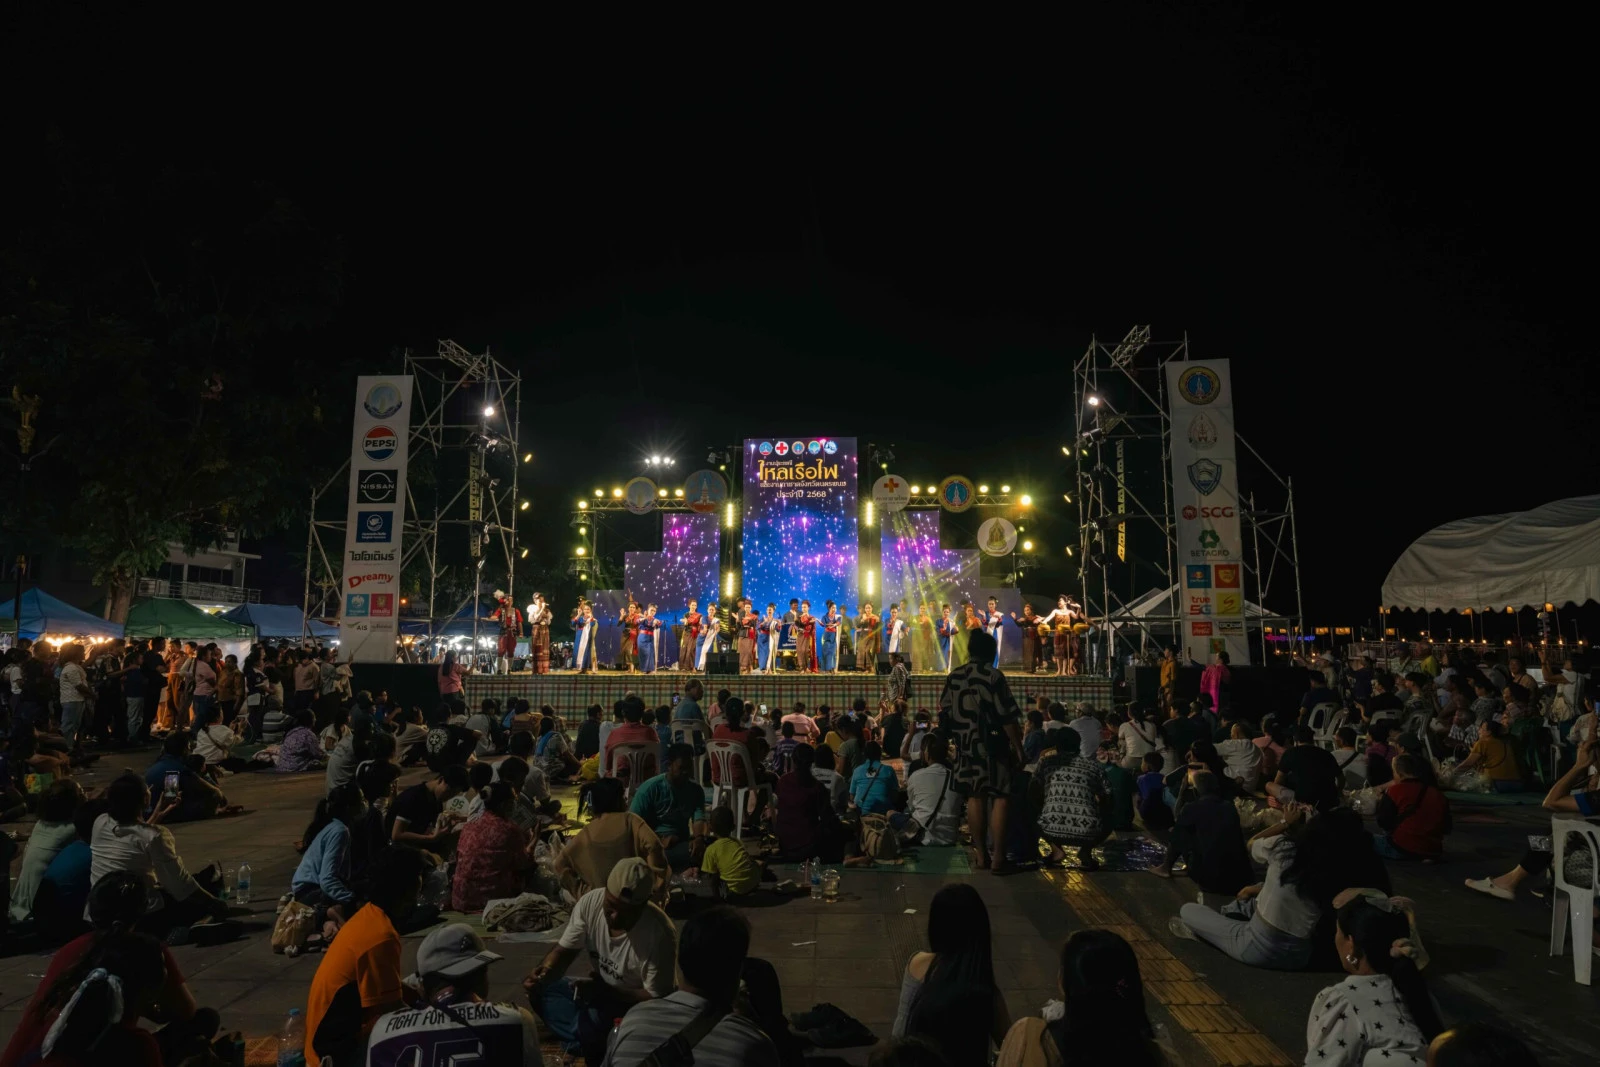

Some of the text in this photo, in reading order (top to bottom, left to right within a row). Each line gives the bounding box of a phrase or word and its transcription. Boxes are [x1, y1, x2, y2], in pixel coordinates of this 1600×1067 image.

[365, 439, 395, 448] PEPSI
[758, 458, 838, 480] ไหลเรือไฟ
[776, 489, 827, 498] ประจำปี 2568
[1200, 506, 1234, 518] SCG
[1190, 549, 1230, 557] BETAGRO
[348, 573, 394, 589] Dreamy
[1191, 595, 1211, 603] true
[1190, 604, 1212, 615] 5G
[385, 1004, 500, 1033] FIGHT FOR REAMS
